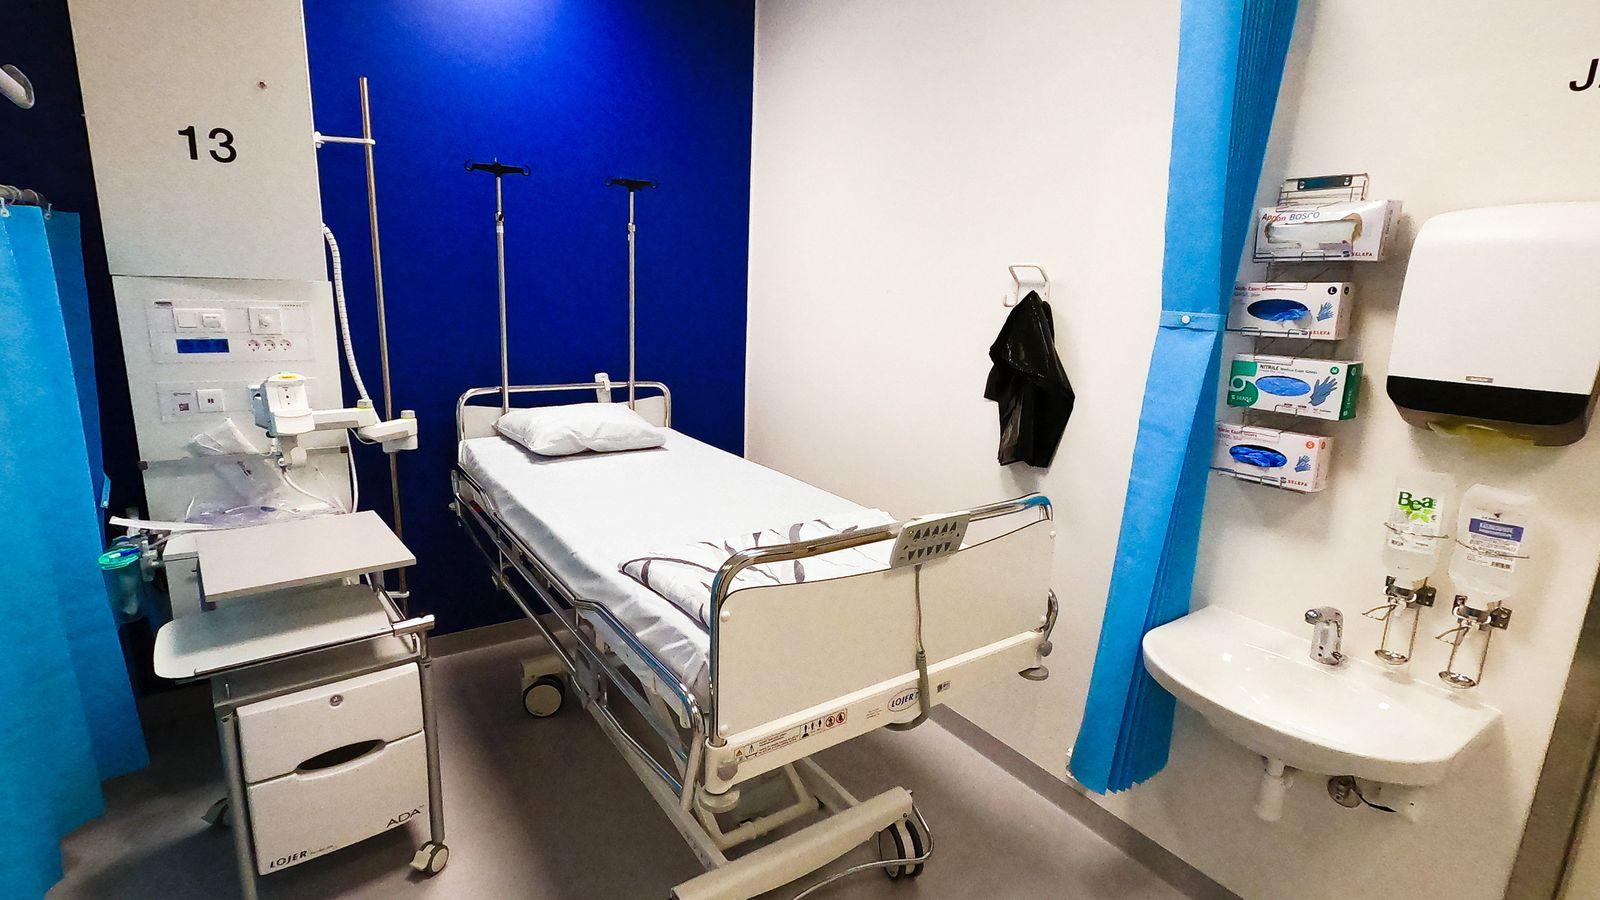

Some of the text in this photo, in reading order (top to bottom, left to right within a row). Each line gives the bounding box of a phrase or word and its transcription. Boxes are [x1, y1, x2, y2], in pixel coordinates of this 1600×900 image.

[1569, 58, 1600, 91] J
[178, 126, 237, 163] 13
[1287, 479, 1308, 487] SELEFA
[1398, 491, 1434, 511] Bea
[891, 692, 915, 708] LOJER
[386, 808, 421, 828] ADA
[270, 850, 308, 868] LOJER
